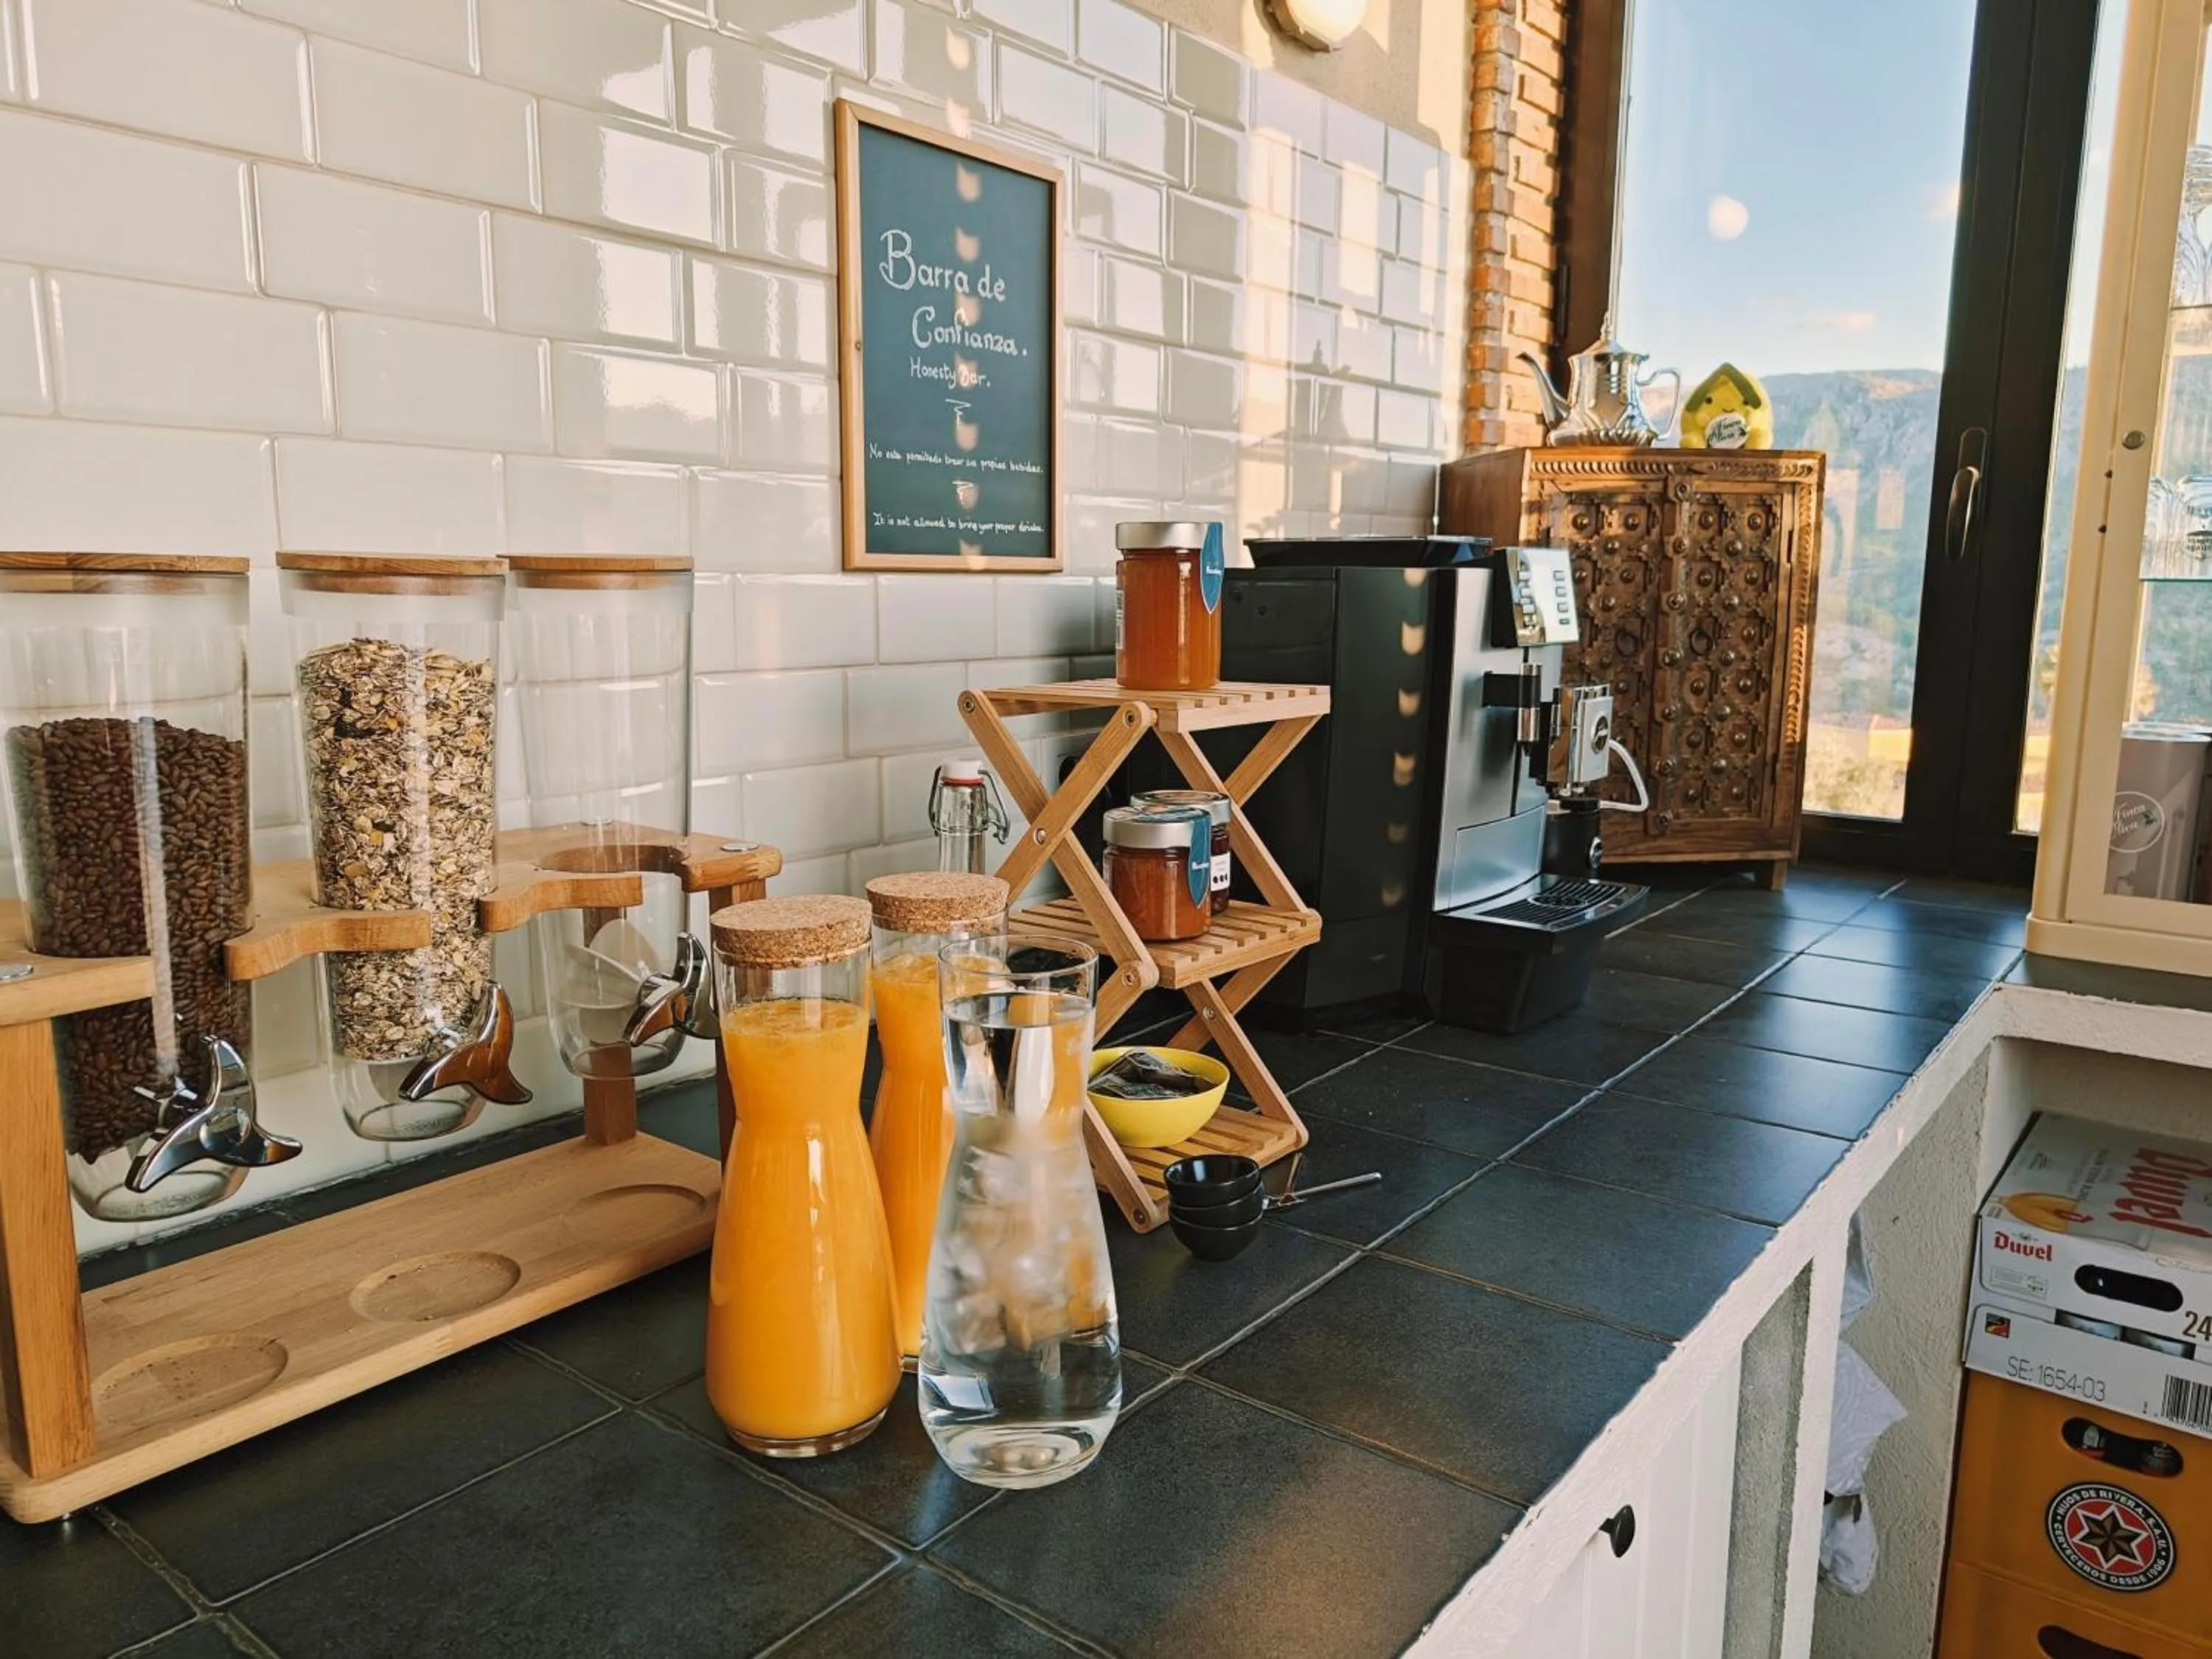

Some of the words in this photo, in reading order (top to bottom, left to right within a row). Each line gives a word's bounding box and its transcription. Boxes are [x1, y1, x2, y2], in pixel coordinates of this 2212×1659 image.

[879, 229, 970, 293] Barra
[977, 264, 1005, 302] de
[912, 306, 1027, 356] Confianza.
[910, 355, 956, 389] Honesty
[869, 442, 883, 459] No
[872, 512, 885, 526] It
[887, 514, 894, 526] is
[896, 515, 911, 526] not
[947, 518, 957, 529] to
[958, 515, 978, 532] bring
[2108, 1147, 2212, 1239] Duvel
[1993, 1231, 2052, 1262] Duvel
[2007, 1356, 2034, 1381] SE:
[2037, 1365, 2106, 1401] 1654-03
[2081, 1489, 2098, 1498] DE
[2053, 1522, 2107, 1581] CERVECEROS
[2109, 1576, 2148, 1585] DESDE
[2146, 1557, 2166, 1579] 1906
